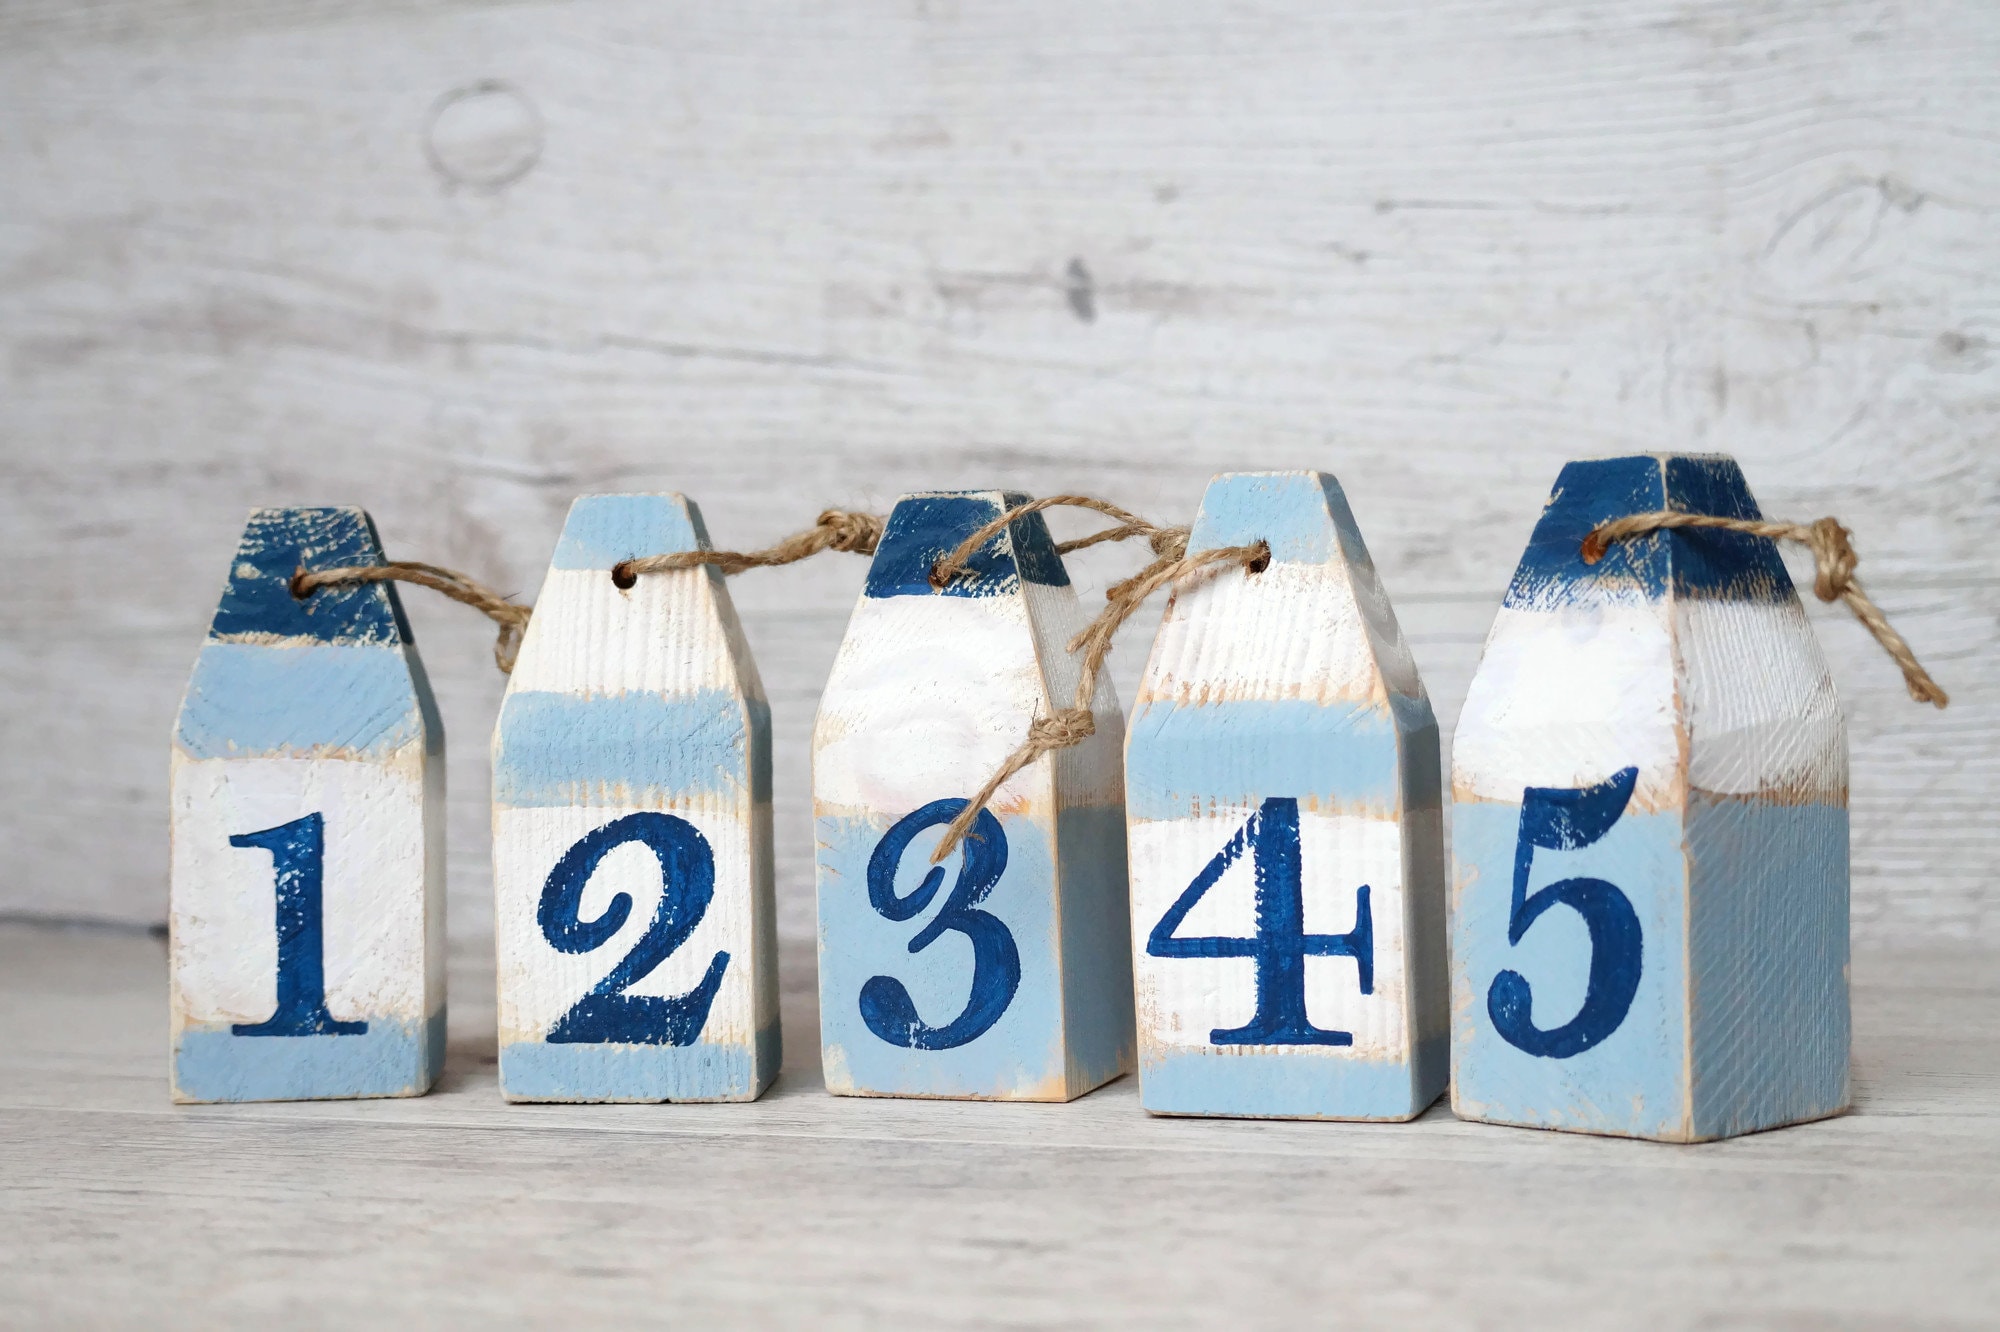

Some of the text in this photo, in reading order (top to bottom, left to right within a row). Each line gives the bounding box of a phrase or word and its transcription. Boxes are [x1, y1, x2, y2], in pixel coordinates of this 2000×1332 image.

[229, 812, 369, 1038] 1
[536, 811, 731, 1048] 2
[858, 797, 1022, 1051] 3
[1146, 797, 1375, 1047] 4
[1487, 767, 1644, 1059] 5
